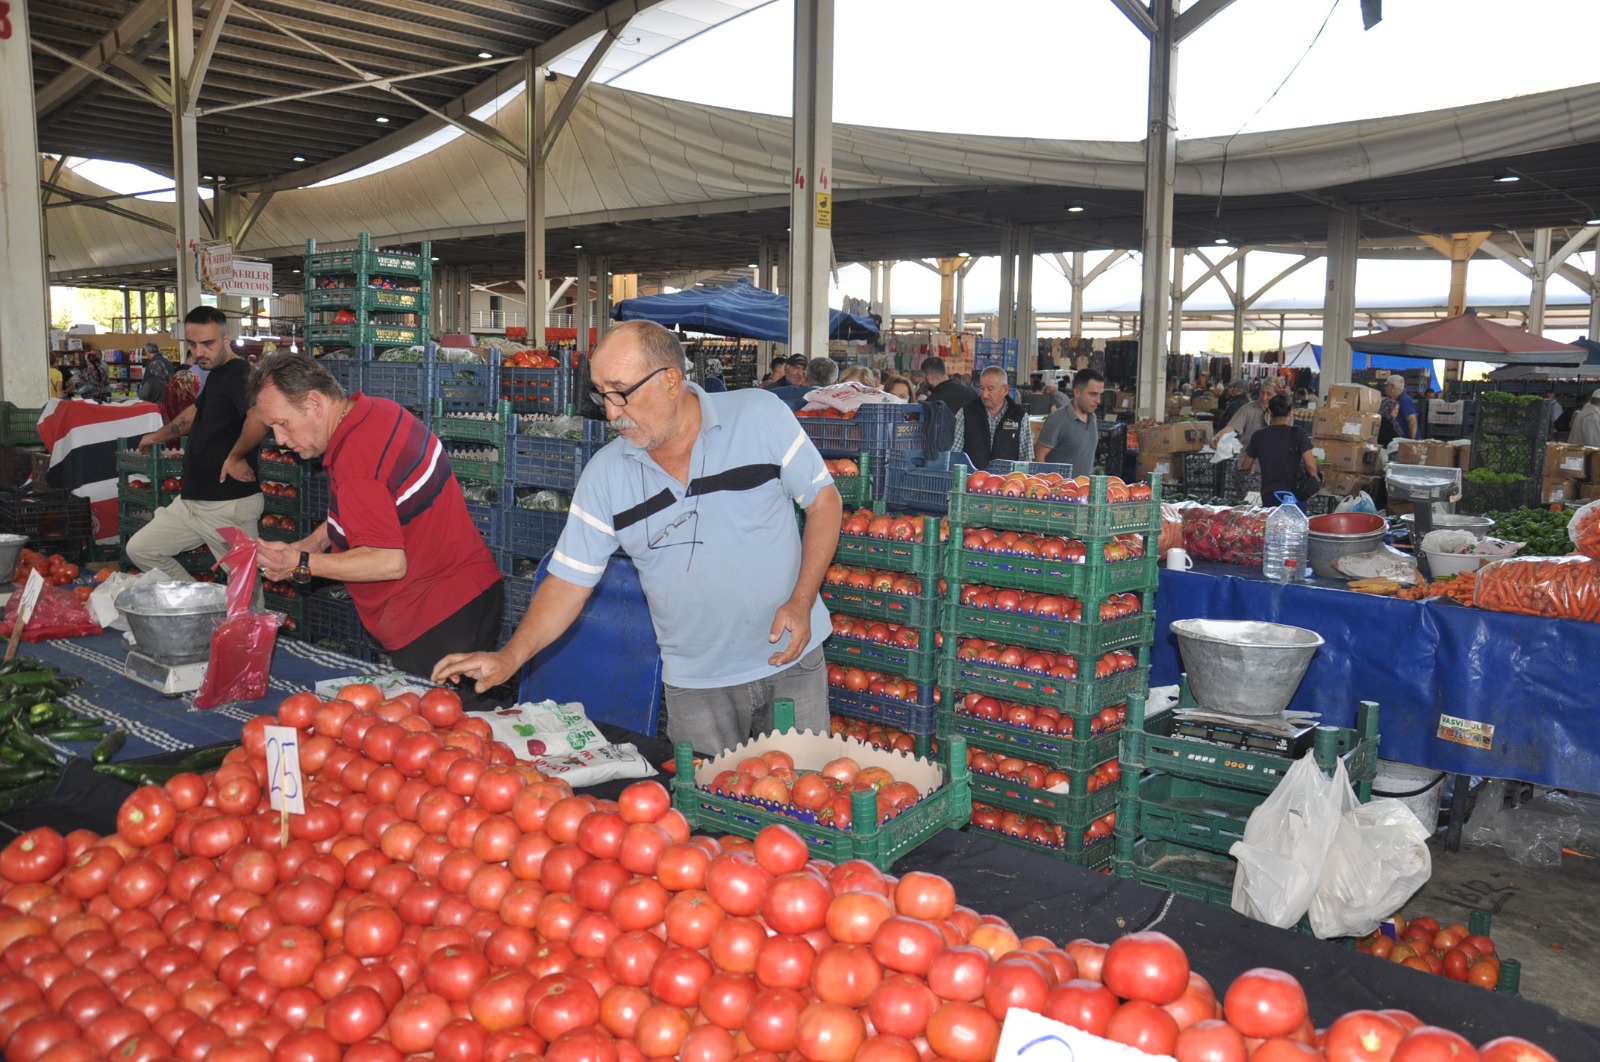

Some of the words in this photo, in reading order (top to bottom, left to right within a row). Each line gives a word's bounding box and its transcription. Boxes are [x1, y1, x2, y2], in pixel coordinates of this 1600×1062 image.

[795, 167, 804, 189] 4
[819, 167, 827, 190] 4
[232, 269, 269, 280] KERLER
[537, 269, 543, 281] 5
[1454, 306, 1460, 316] 7
[267, 737, 298, 799] 25
